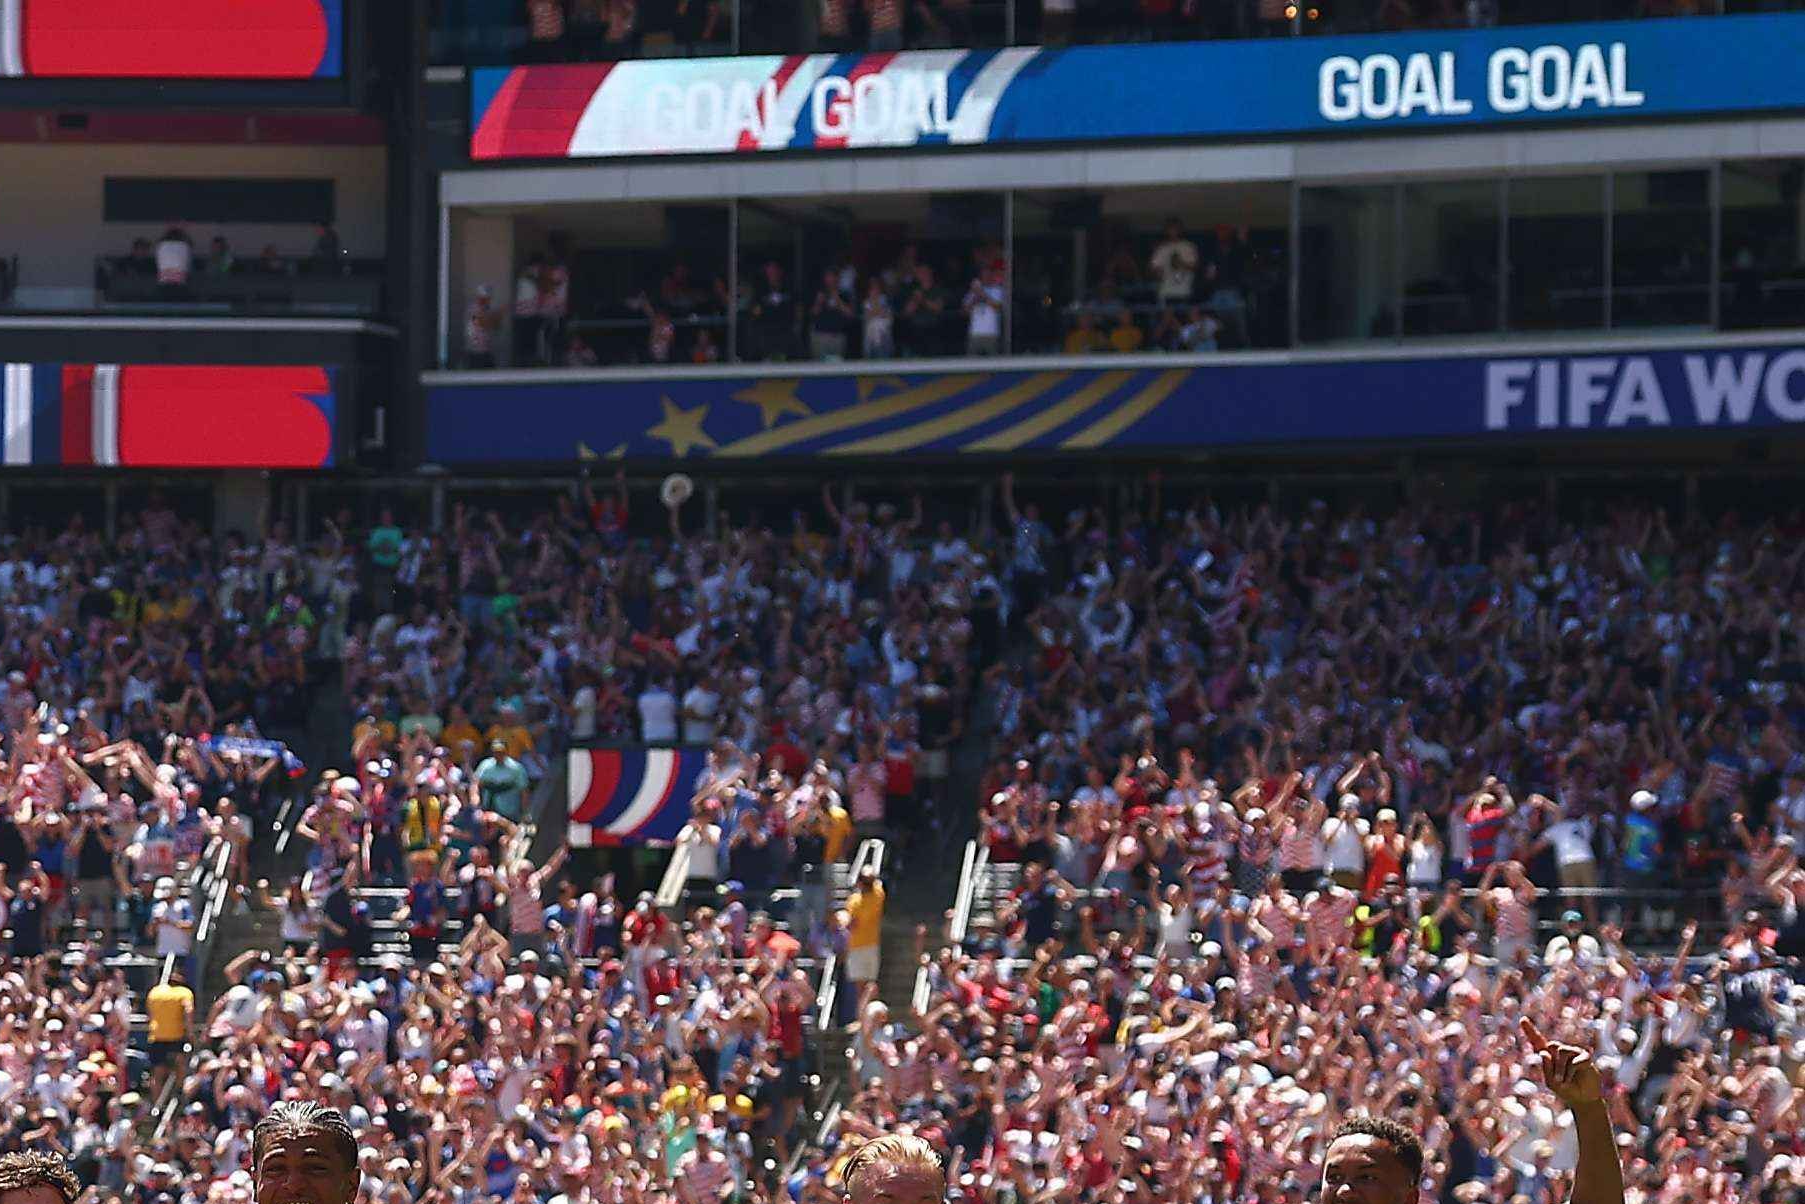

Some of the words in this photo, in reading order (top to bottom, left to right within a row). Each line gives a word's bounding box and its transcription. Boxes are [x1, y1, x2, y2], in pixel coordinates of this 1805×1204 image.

[811, 67, 962, 137] GOAL
[1319, 51, 1473, 121] GOAL
[1489, 42, 1644, 113] GOAL
[1485, 356, 1672, 431] FIFA
